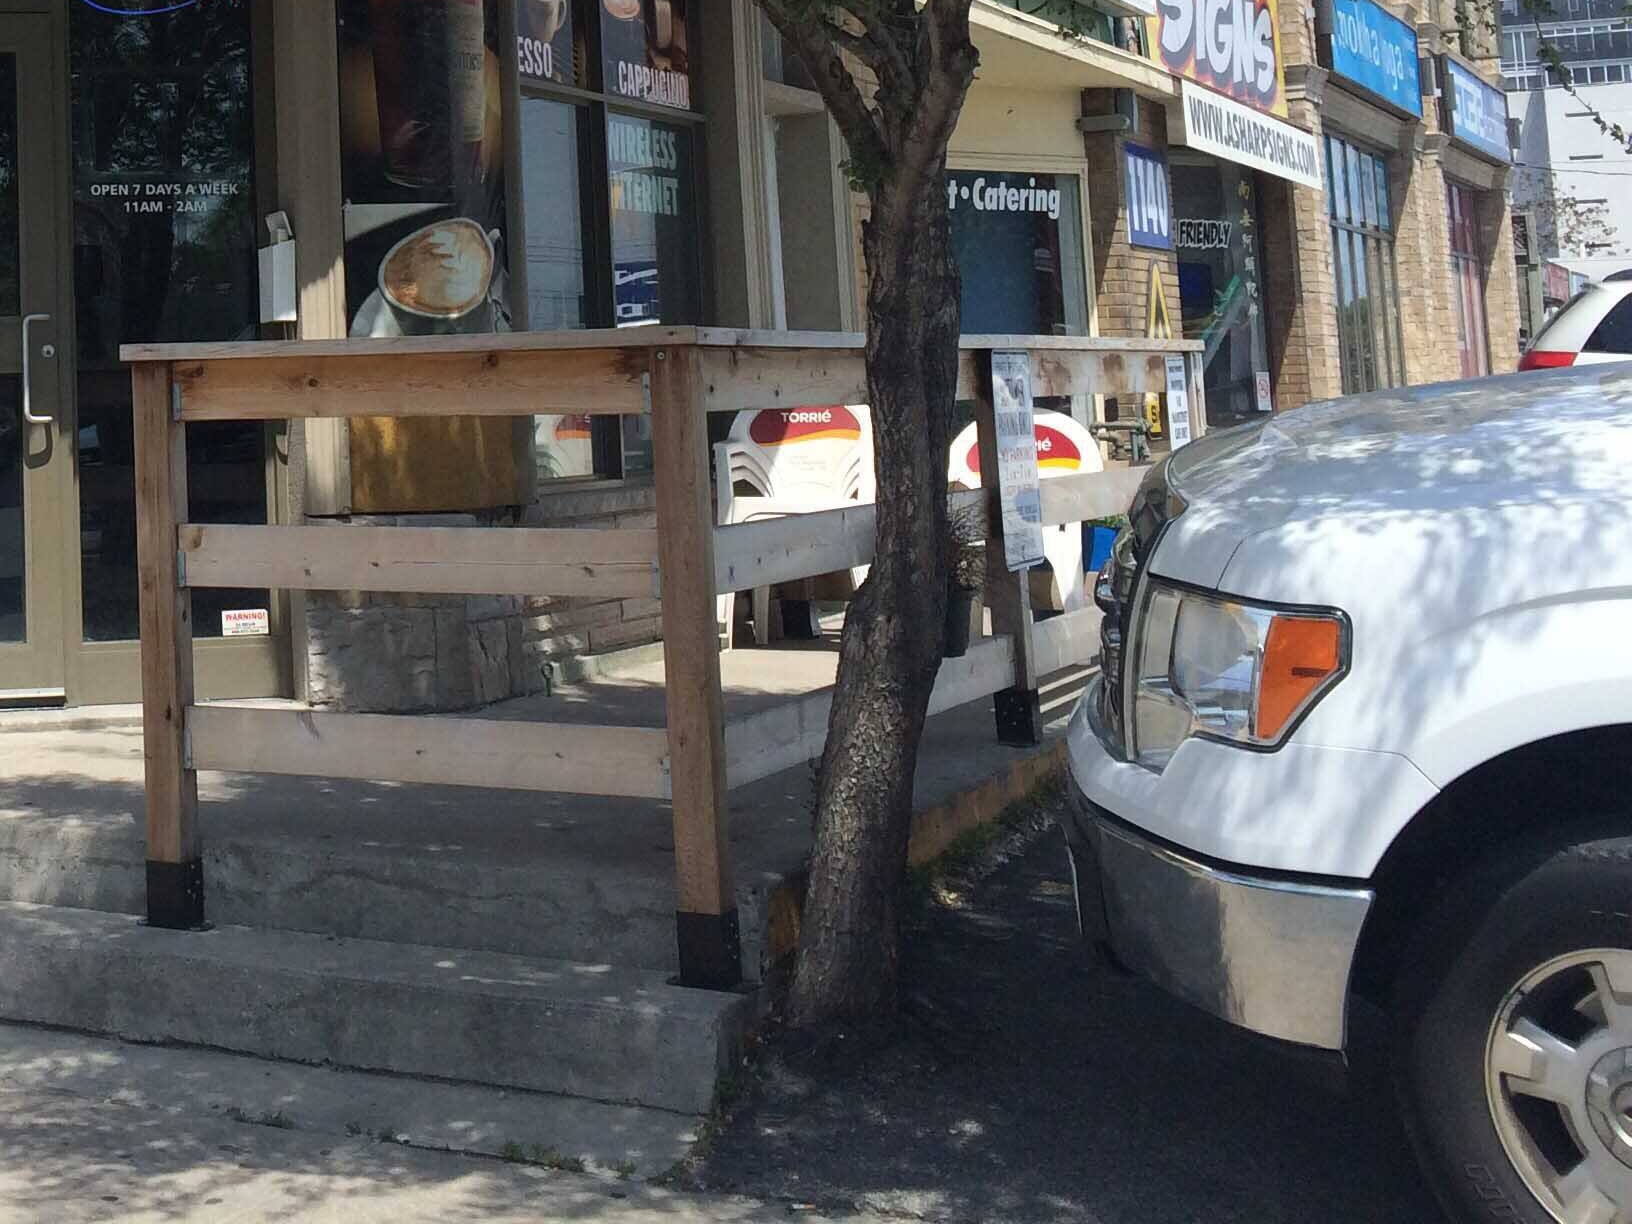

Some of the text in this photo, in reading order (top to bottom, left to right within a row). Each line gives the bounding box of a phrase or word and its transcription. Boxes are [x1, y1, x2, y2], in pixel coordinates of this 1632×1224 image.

[1189, 95, 1316, 177] WWW.ASHARPSIGNS.COM
[91, 183, 239, 196] OPEN 7 DAYS A WEEK
[973, 177, 1061, 219] Catering
[124, 201, 163, 213] 11AM
[176, 201, 208, 212] 2AM
[1178, 219, 1232, 249] FRIENDLY
